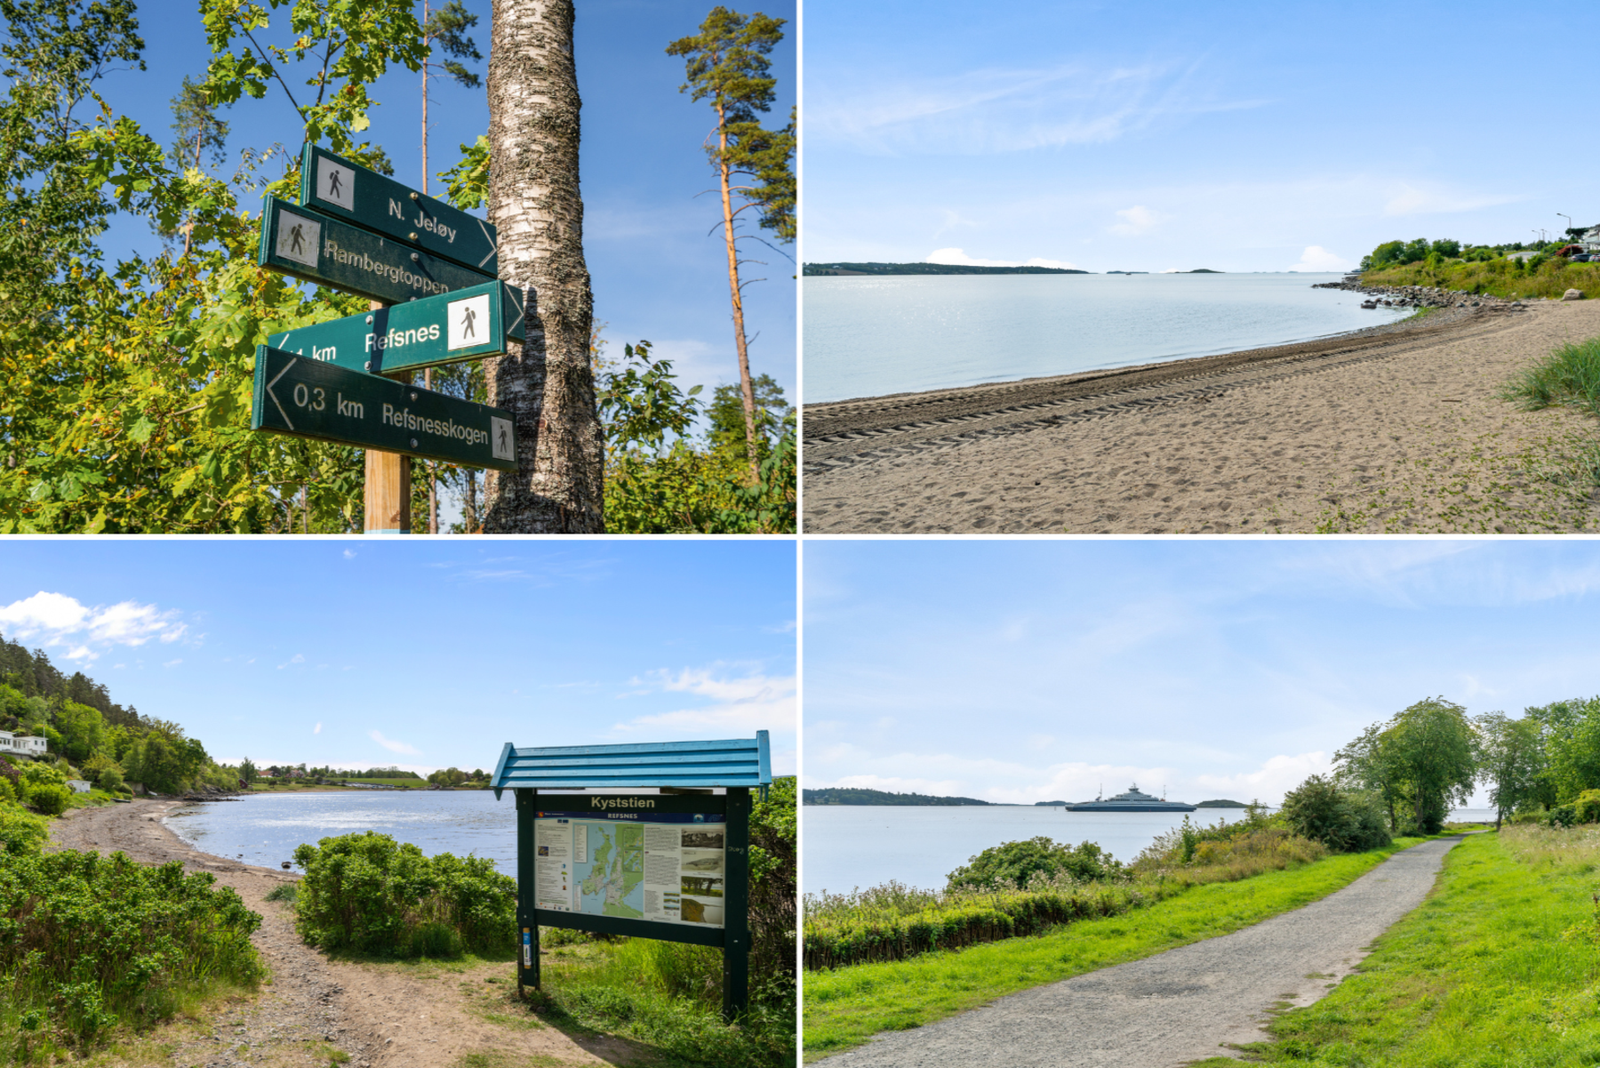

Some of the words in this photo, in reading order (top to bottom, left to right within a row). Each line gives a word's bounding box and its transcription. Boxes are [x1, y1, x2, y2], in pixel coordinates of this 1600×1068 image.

[389, 198, 405, 221] N.
[414, 211, 457, 244] Jeløy
[325, 239, 449, 294] Rambergtoppen
[312, 345, 337, 361] km
[365, 324, 440, 353] Refsnes
[293, 383, 326, 412] 0,3
[337, 392, 364, 419] km
[382, 403, 489, 445] Refsnesskogen
[591, 796, 655, 811] Kyststien
